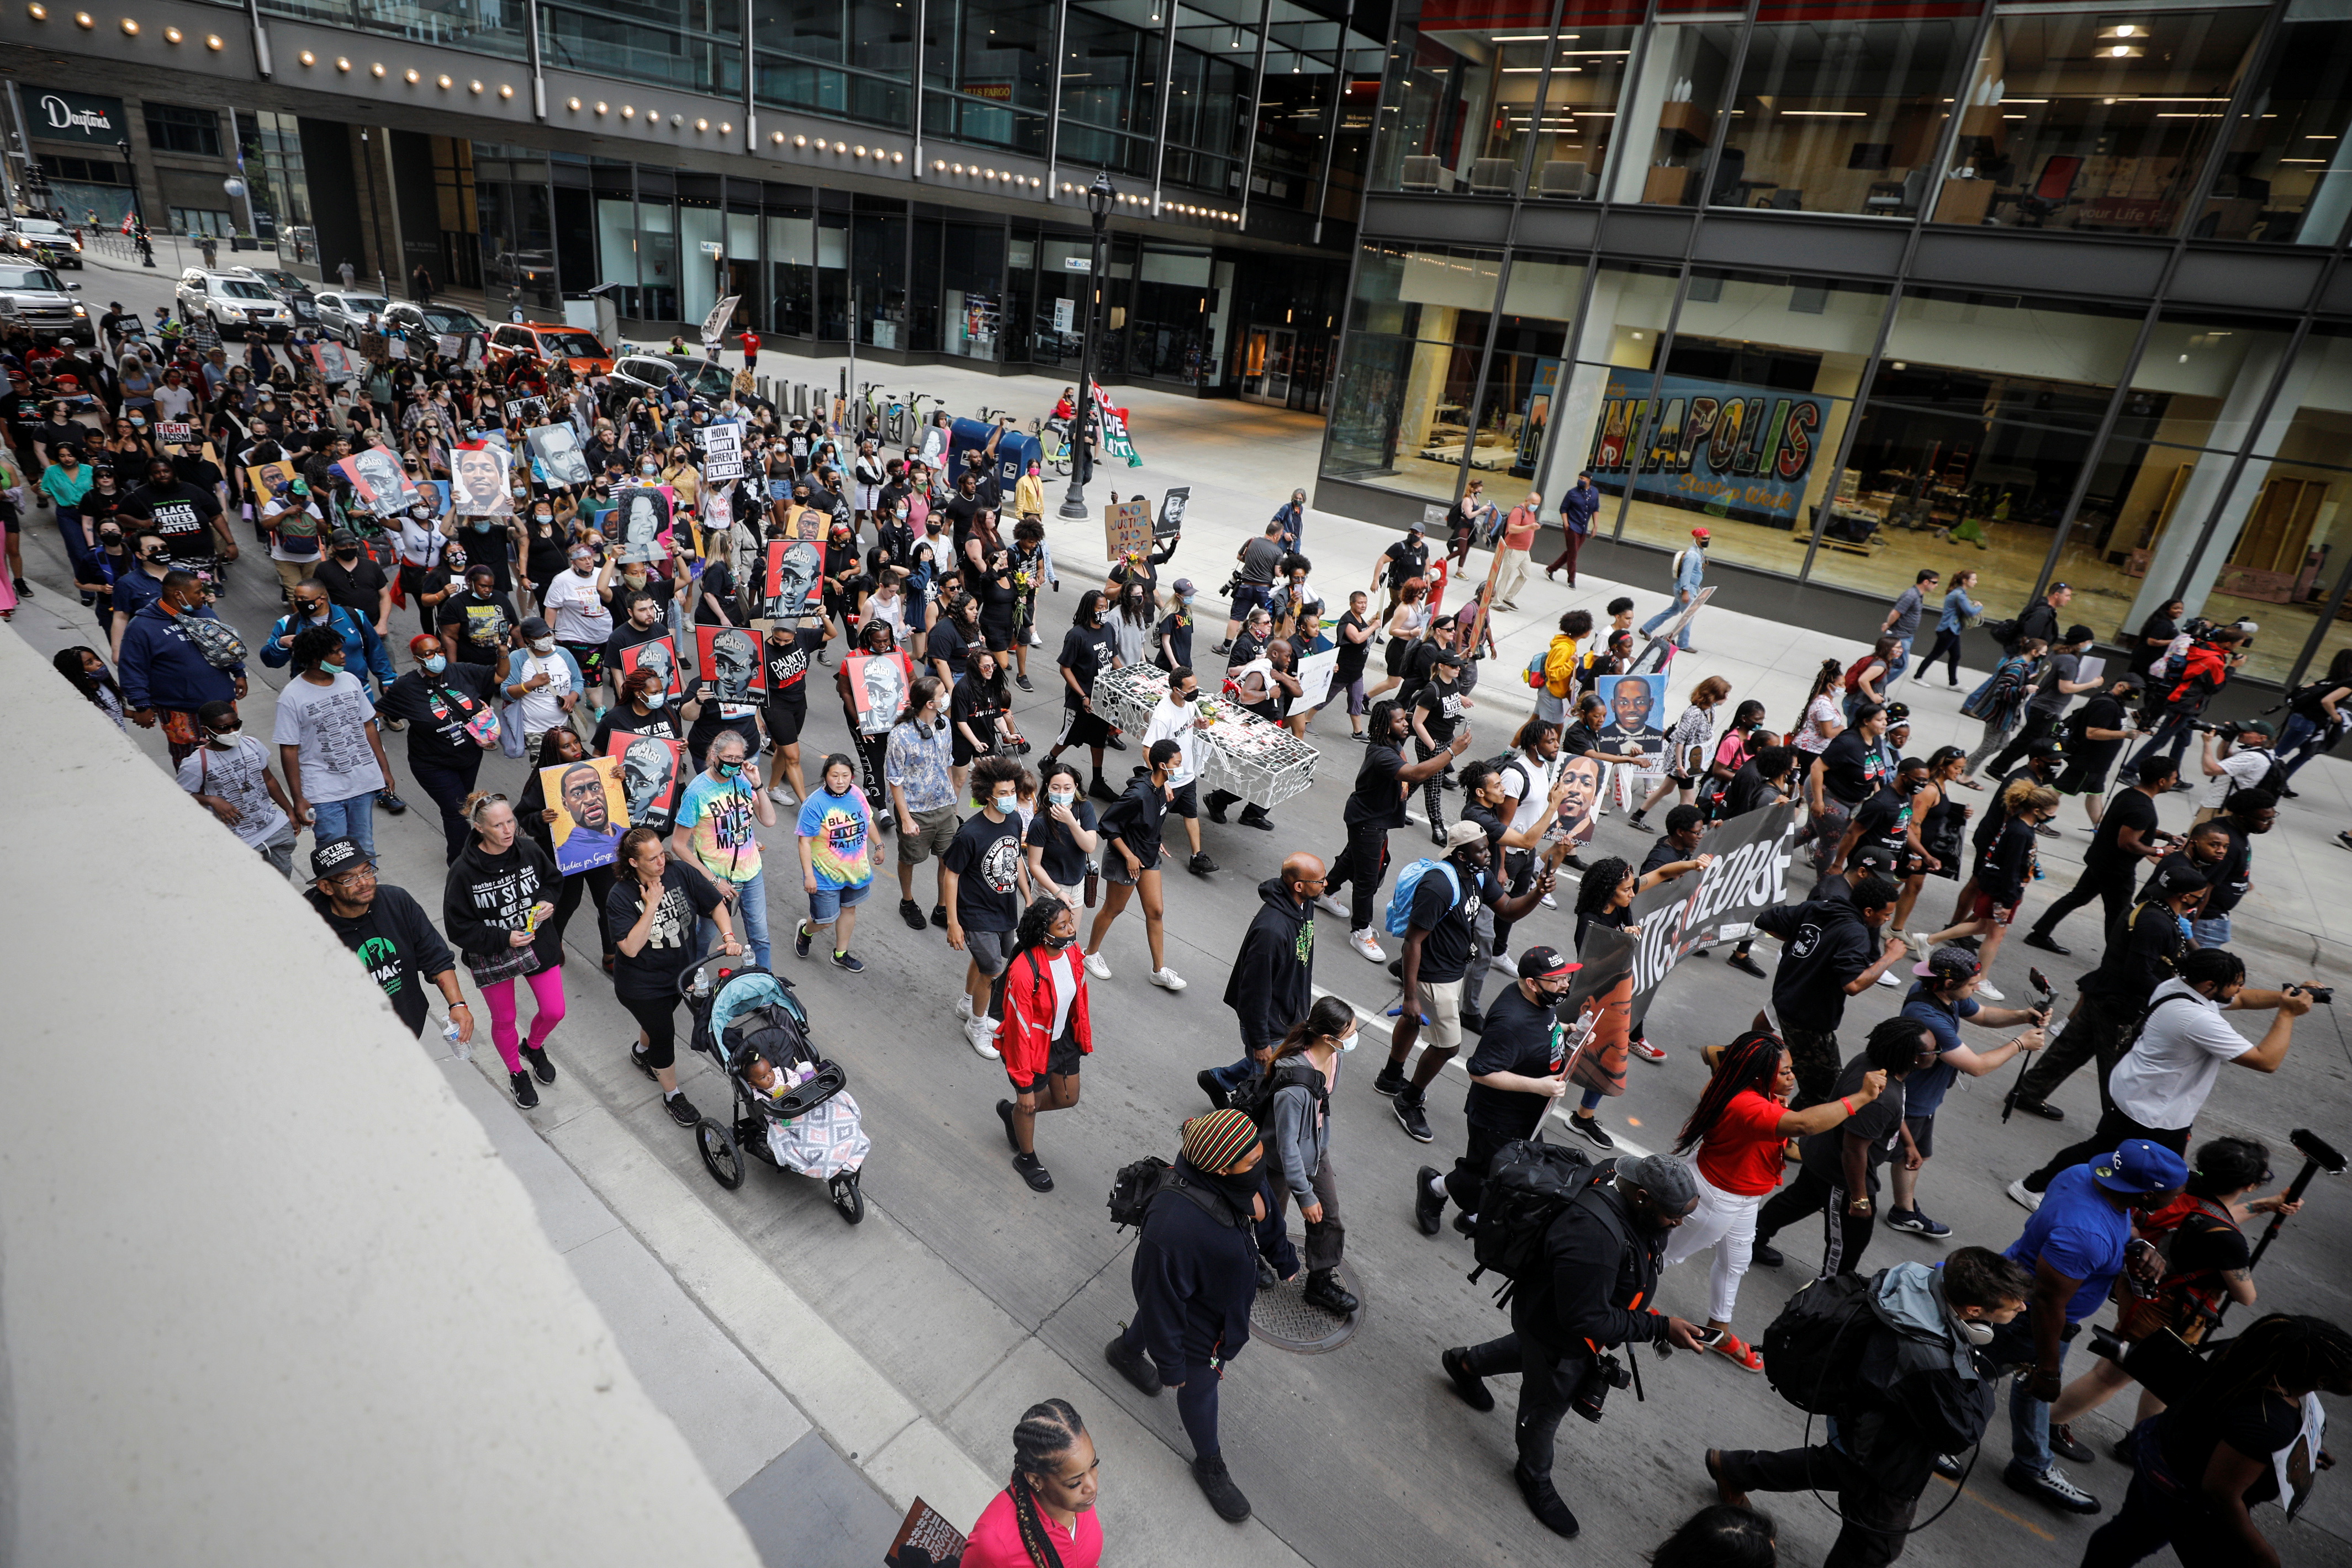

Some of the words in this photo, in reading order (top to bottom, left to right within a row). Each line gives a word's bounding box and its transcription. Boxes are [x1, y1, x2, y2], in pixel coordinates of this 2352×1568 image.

[984, 87, 1010, 97] FARGO
[41, 95, 111, 135] Dayton's
[2115, 208, 2144, 222] Life
[1067, 257, 1081, 266] FedEx
[511, 398, 544, 413] BLK
[156, 423, 188, 433] FIGHT
[711, 427, 728, 438] HOW
[158, 433, 192, 441] RACISM
[711, 439, 733, 452] MANY
[709, 452, 739, 464] WEREN'T
[356, 458, 382, 472] CHICAGO
[708, 464, 741, 477] FILMED?
[1677, 473, 1741, 501] Startup
[1744, 486, 1793, 511] Week
[155, 504, 193, 517] BLACK
[1119, 505, 1141, 517] NO
[158, 515, 193, 525] LIVES
[1109, 516, 1148, 530] JUSTICE
[159, 523, 201, 534] MATTER
[1119, 528, 1140, 541] NO
[1111, 540, 1148, 554] PEACE
[783, 552, 811, 564] CHICAGO
[466, 605, 494, 614] MARCH
[766, 608, 781, 617] Justice
[713, 637, 746, 651] CHICAGO
[1093, 642, 1107, 651] BLACK
[586, 653, 600, 665] LOVE
[637, 653, 661, 666] CHICAGO
[770, 648, 806, 672] DAUNTE
[775, 659, 806, 680] WRIGHT
[864, 666, 890, 677] CHICAGO
[549, 674, 563, 682] N'T
[530, 680, 569, 693] REATHE
[1444, 700, 1462, 712] LIVE
[659, 721, 670, 733] FOR
[863, 723, 877, 732] Justice
[627, 746, 661, 764] CHICAGO
[628, 814, 647, 824] Daunte
[647, 816, 665, 827] Wright
[828, 811, 863, 827] BLACK
[831, 822, 865, 838] LIVES
[1550, 827, 1568, 835] JUSTICE
[829, 834, 864, 849] MATTER
[1003, 838, 1015, 846] OFF
[1570, 838, 1590, 848] ROOKS
[1881, 837, 1904, 845] GEORGE
[319, 846, 335, 858] AIN'T
[989, 840, 1004, 857] KNEE
[320, 856, 330, 865] YET
[326, 851, 355, 867] FUCKERS
[559, 860, 584, 873] Justice
[584, 857, 593, 868] for
[594, 852, 613, 866] George
[983, 857, 993, 873] YOUR
[986, 874, 998, 887] GET
[1687, 821, 1795, 930] GEORGE
[472, 881, 496, 891] Mother
[473, 891, 497, 909] MY
[660, 886, 685, 909] RISE
[652, 900, 691, 925] GETHER
[1698, 939, 1719, 949] JUSTICE
[387, 977, 401, 987] Police
[2112, 1150, 2122, 1170] KC
